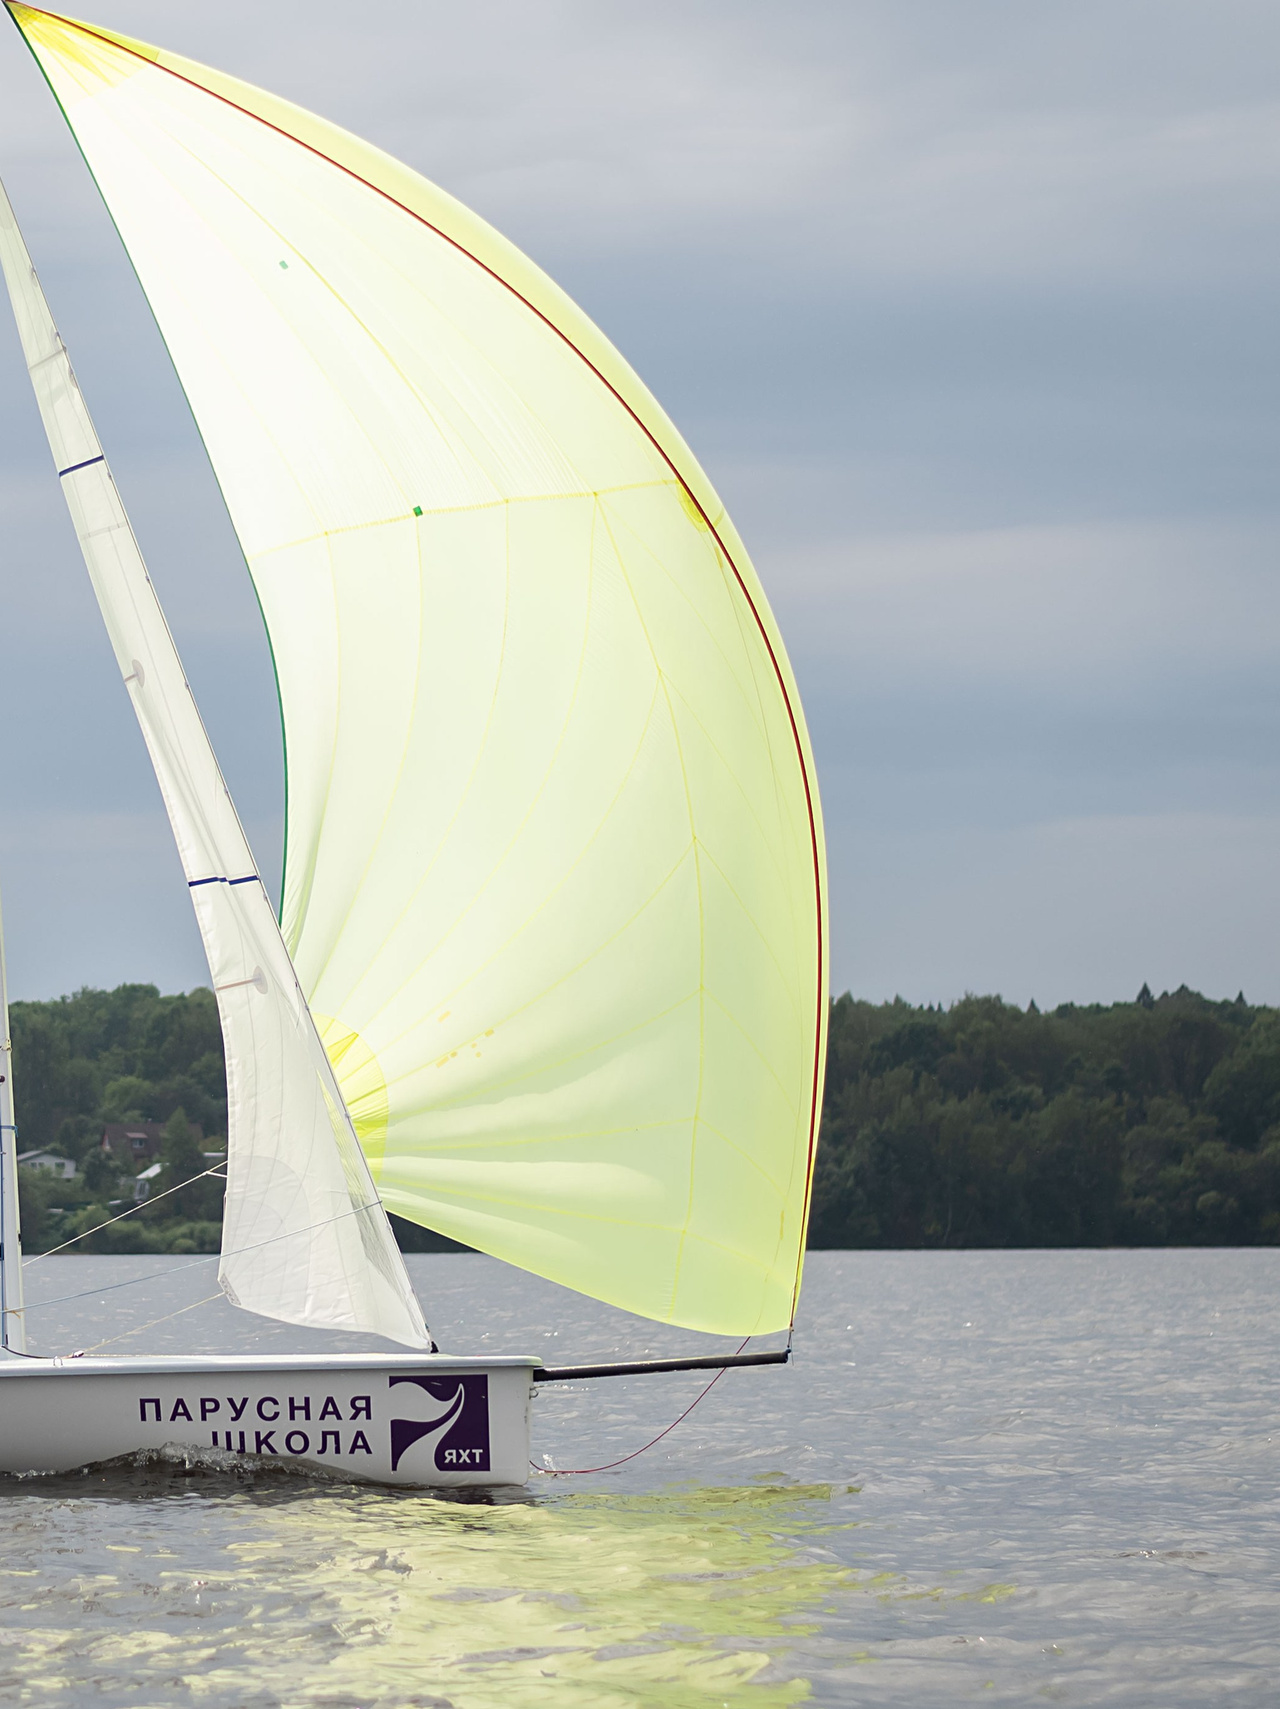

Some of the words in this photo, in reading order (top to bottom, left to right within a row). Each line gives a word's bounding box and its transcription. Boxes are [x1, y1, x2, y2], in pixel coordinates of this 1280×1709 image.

[139, 1395, 373, 1422] ПАРУСНАЯ
[211, 1430, 373, 1455] ШКОЛА
[444, 1448, 484, 1464] ЯХТ
